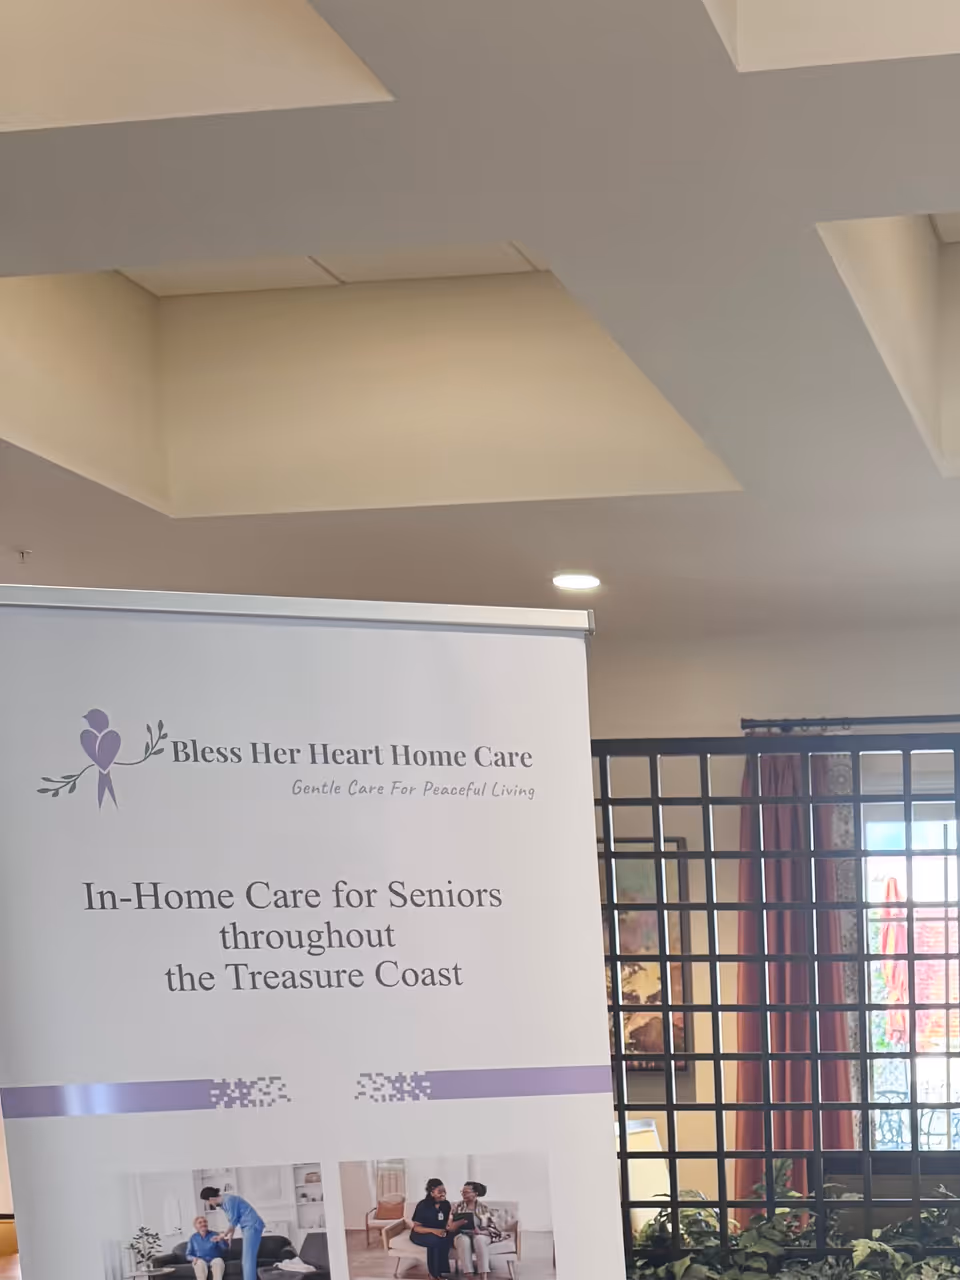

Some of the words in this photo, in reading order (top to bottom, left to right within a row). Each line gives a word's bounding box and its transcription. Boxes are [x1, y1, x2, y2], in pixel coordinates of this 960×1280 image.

[171, 740, 242, 763] Bless
[251, 743, 300, 764] Her
[309, 744, 383, 765] Heart
[391, 745, 466, 766] Home
[475, 746, 532, 767] Care
[292, 780, 340, 795] Gentle
[348, 780, 384, 795] Care
[391, 781, 416, 795] For
[424, 781, 486, 796] Peaceful
[492, 782, 534, 800] Living
[83, 882, 234, 910] In-Home
[246, 882, 320, 908] Care
[332, 881, 377, 908] for
[389, 880, 502, 907] Seniors
[220, 921, 395, 956] throughout
[165, 964, 215, 991] the
[225, 964, 364, 990] Treasure
[376, 961, 463, 987] Coast
